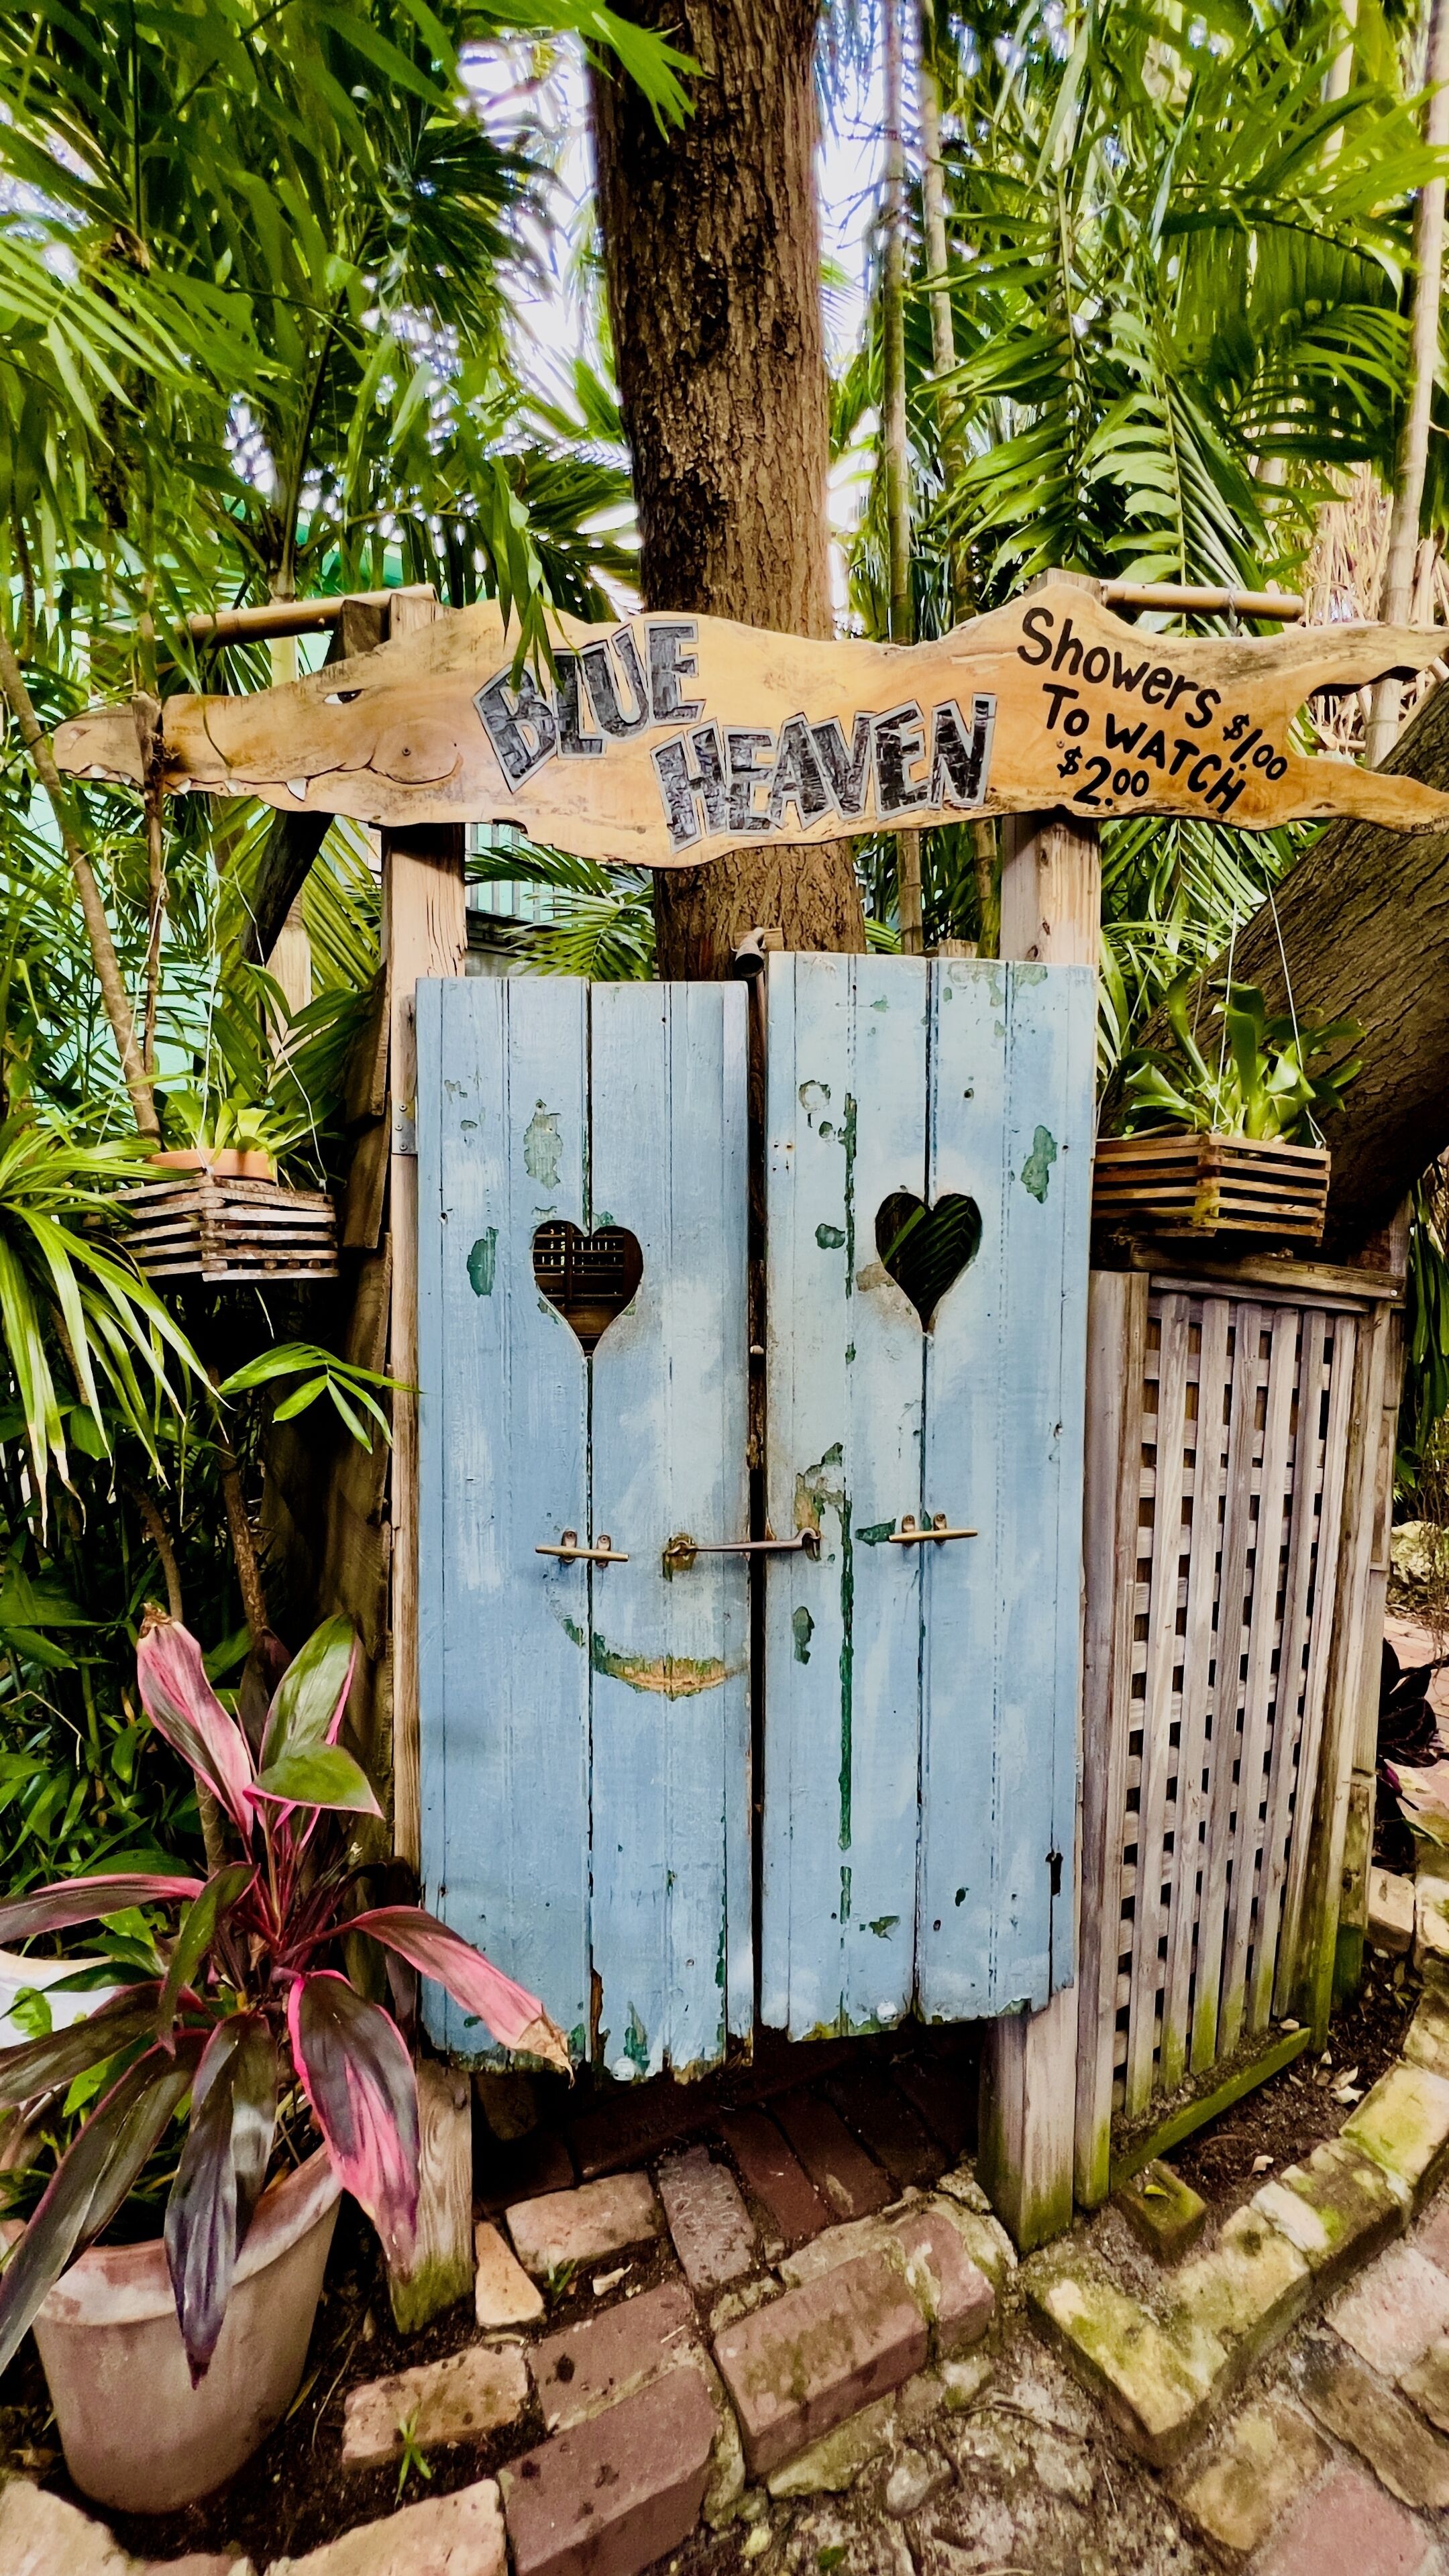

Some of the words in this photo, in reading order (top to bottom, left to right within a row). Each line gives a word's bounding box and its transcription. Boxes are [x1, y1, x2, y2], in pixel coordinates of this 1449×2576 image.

[472, 620, 706, 793] BLUE
[1017, 607, 1221, 729] Showers
[650, 692, 997, 853] HEAVEN
[1042, 683, 1089, 737] To
[1106, 713, 1246, 814] WATCH
[1057, 746, 1149, 806] $2.00
